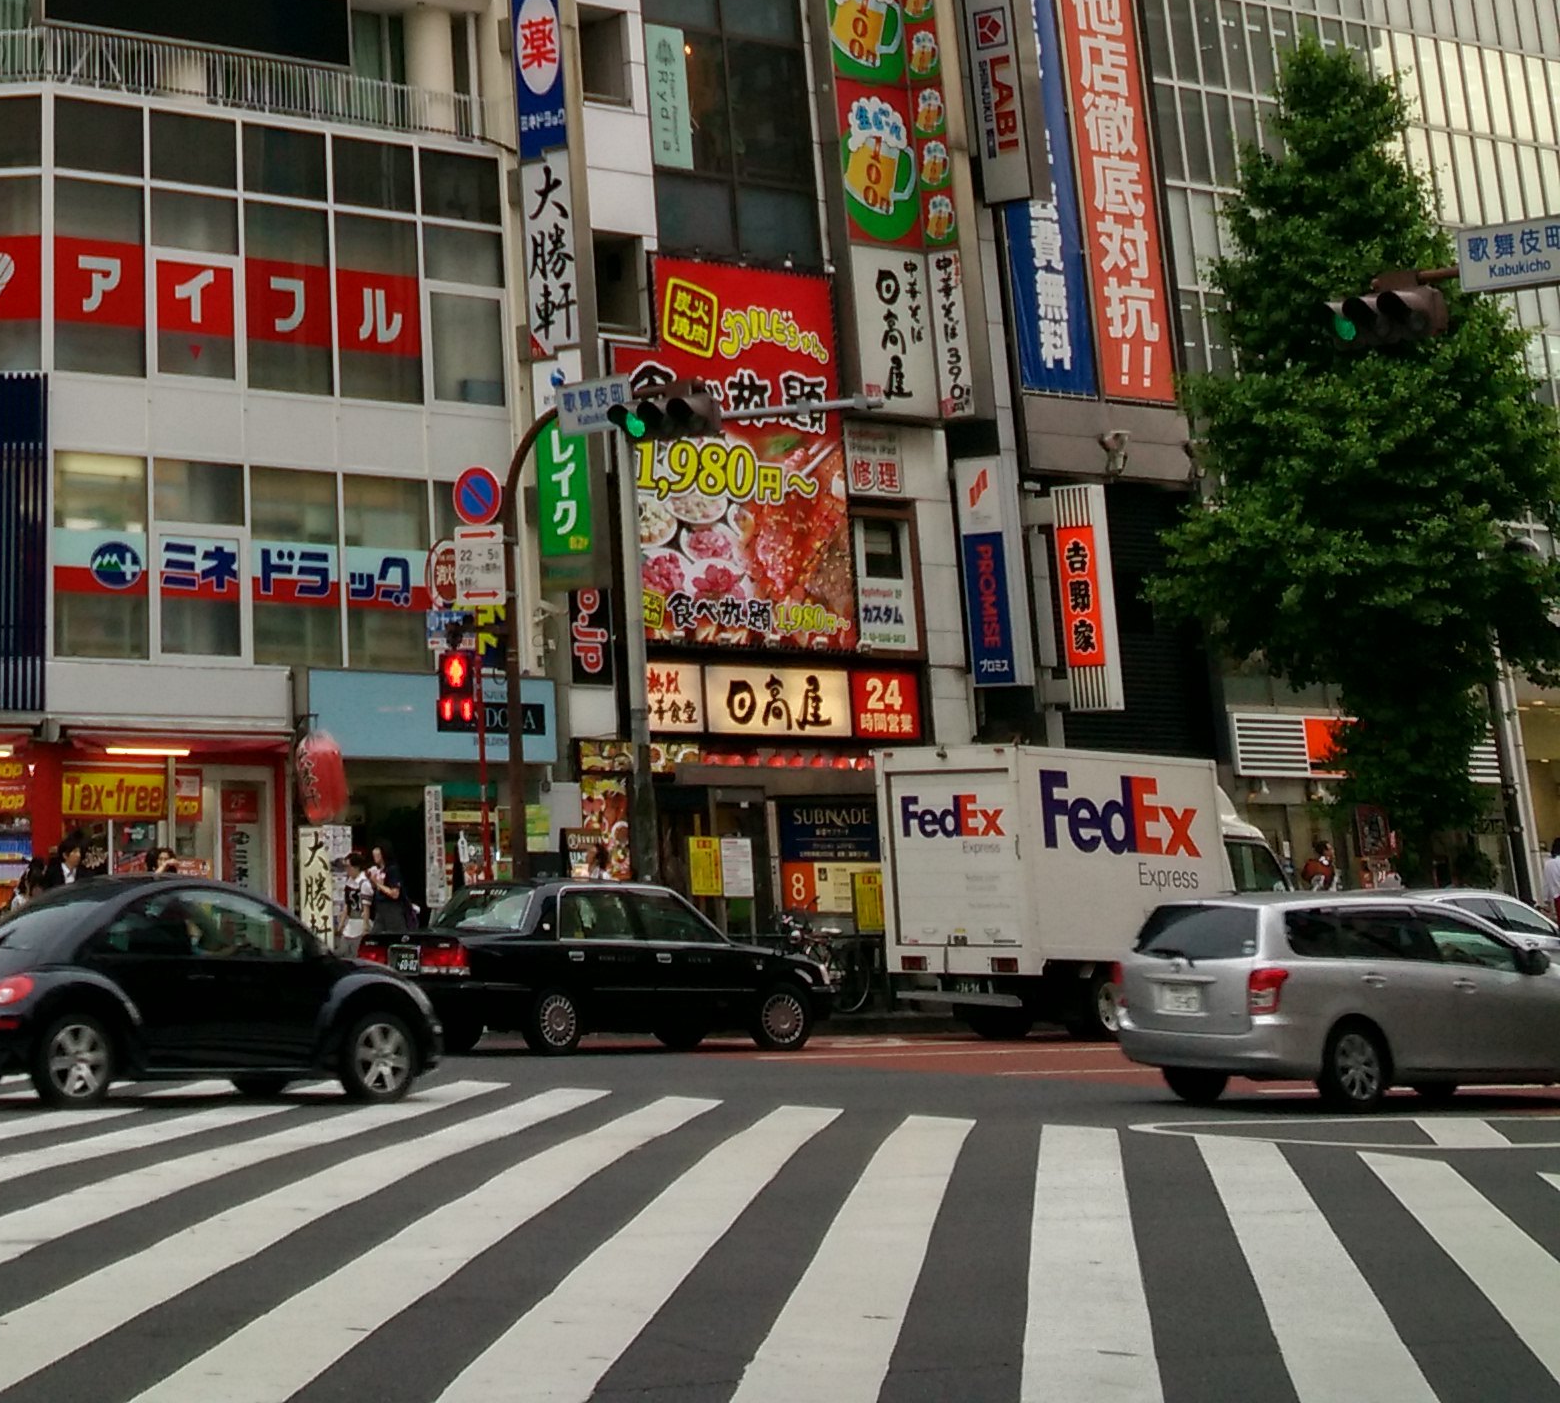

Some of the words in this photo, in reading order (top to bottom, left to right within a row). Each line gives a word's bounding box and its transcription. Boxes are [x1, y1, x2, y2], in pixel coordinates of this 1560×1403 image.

[519, 17, 558, 70] 薬
[977, 59, 993, 125] SHINJUKU
[987, 53, 1021, 156] LABI
[529, 164, 578, 343] 大勝軒
[1488, 257, 1552, 280] Kabukicho
[77, 255, 403, 344] アイフル
[874, 267, 914, 400] 日高屋
[550, 428, 579, 538] レイク
[851, 459, 902, 493] 修理
[667, 591, 772, 632] 食べ放題
[862, 605, 904, 625] カスタム
[975, 544, 1002, 650] PROMISE
[1064, 538, 1097, 654] 吉野家
[979, 658, 1010, 675] プロミス
[726, 673, 833, 732] 日高屋
[865, 677, 903, 712] 24
[860, 712, 914, 735] 時間営業
[64, 773, 165, 815] Tax-free
[900, 793, 1007, 839] FedEx
[1038, 768, 1203, 859] FedEx
[792, 807, 872, 828] SUBNADE
[962, 840, 1001, 855] Express
[791, 872, 806, 901] 8
[1138, 861, 1200, 893] Express
